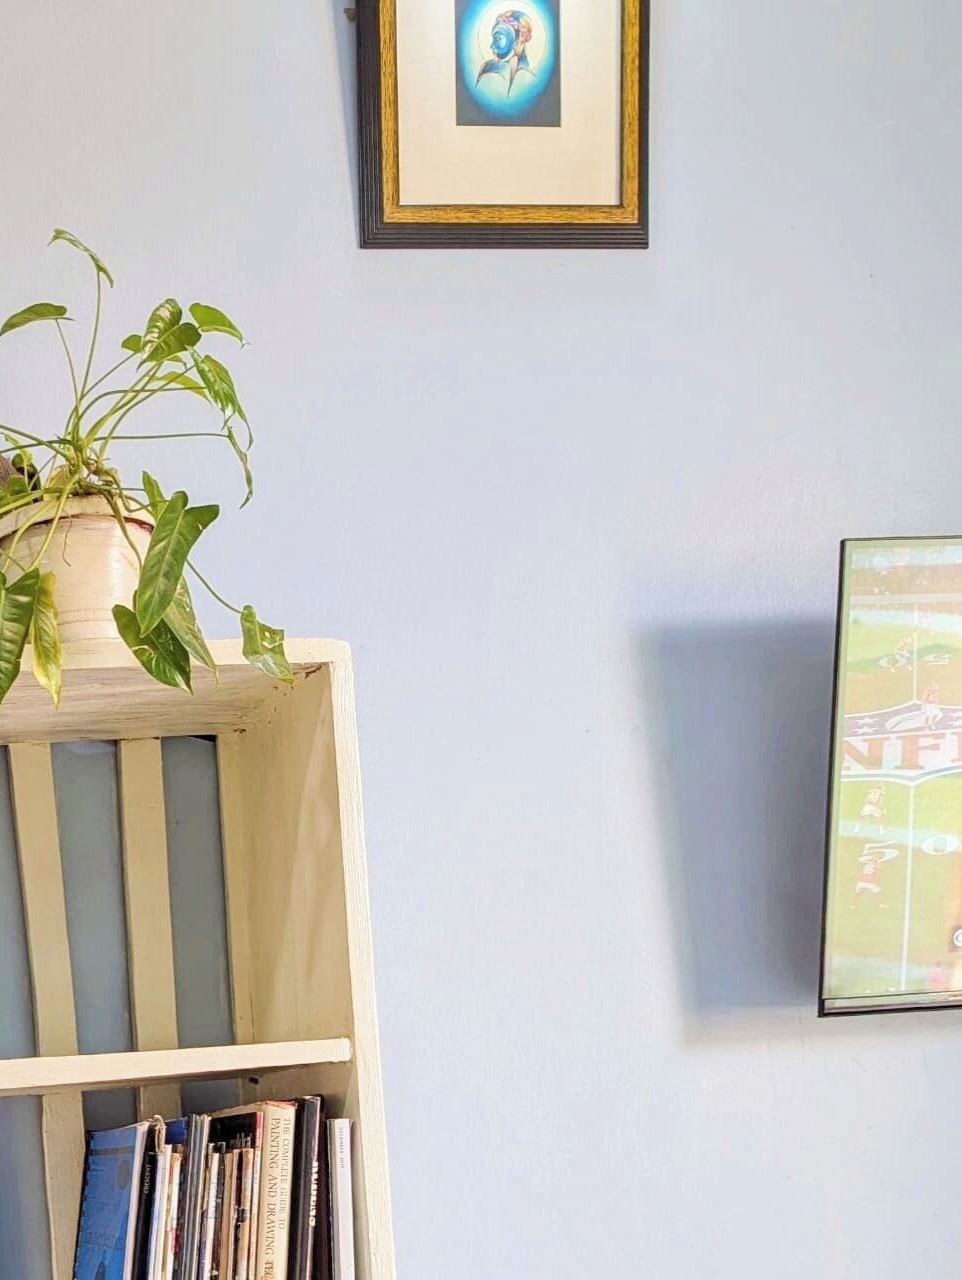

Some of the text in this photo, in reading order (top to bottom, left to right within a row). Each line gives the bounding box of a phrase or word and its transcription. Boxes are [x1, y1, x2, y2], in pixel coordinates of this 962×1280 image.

[268, 1117, 281, 1169] PAINTING
[282, 1117, 291, 1135] THE
[279, 1138, 289, 1184] COMPLETE
[267, 1174, 278, 1198] AND
[264, 1202, 276, 1255] DRAWING
[277, 1217, 285, 1229] TO
